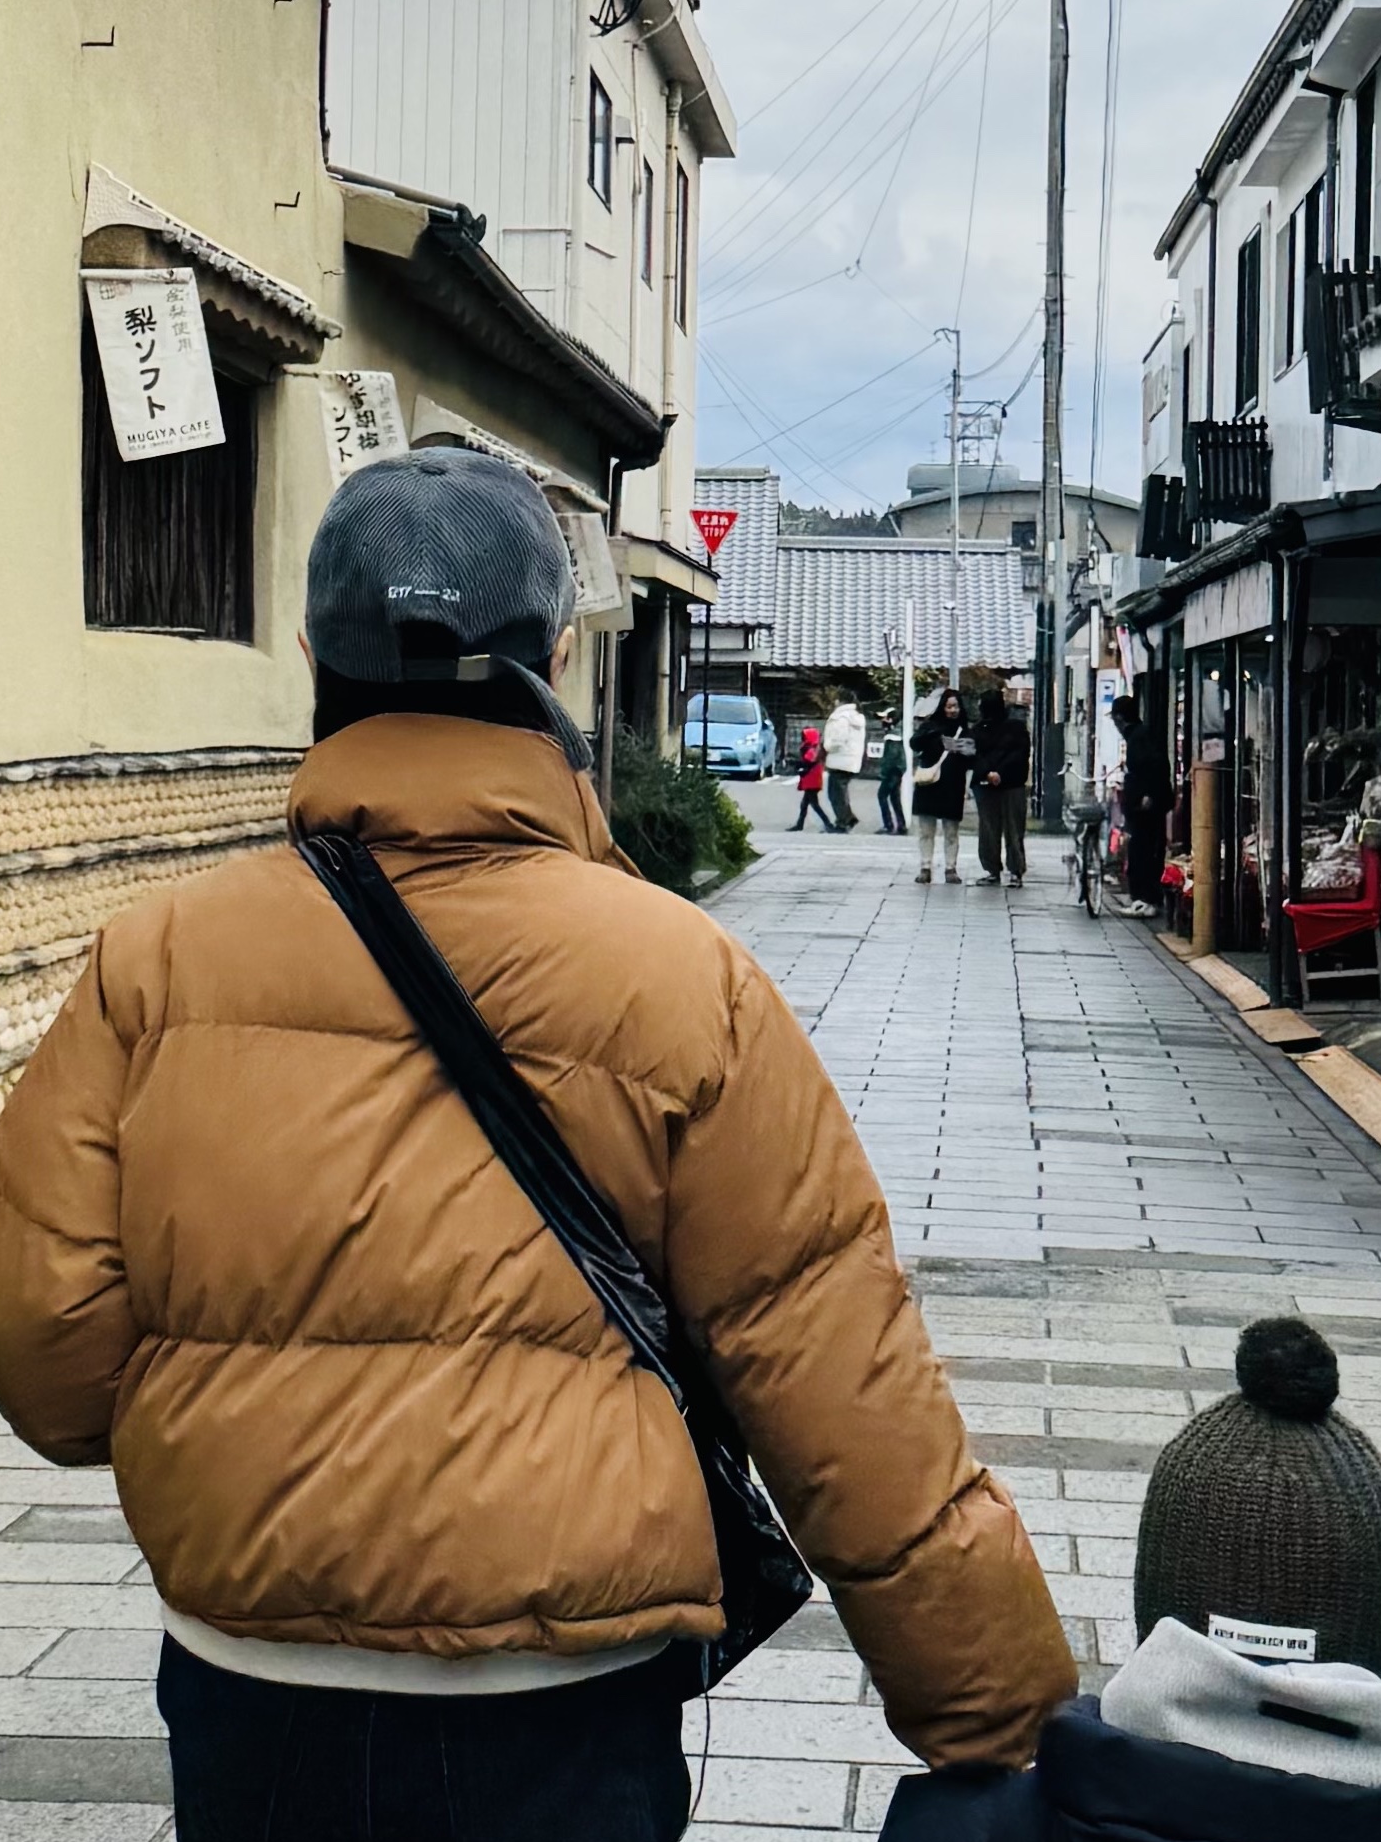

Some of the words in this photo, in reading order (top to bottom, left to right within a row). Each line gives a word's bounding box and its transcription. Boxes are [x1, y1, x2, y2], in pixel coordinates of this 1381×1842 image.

[124, 305, 166, 420] 梨ソフト
[127, 424, 176, 444] MUGIYA
[179, 419, 211, 436] CAFE
[333, 406, 353, 463] ソフト
